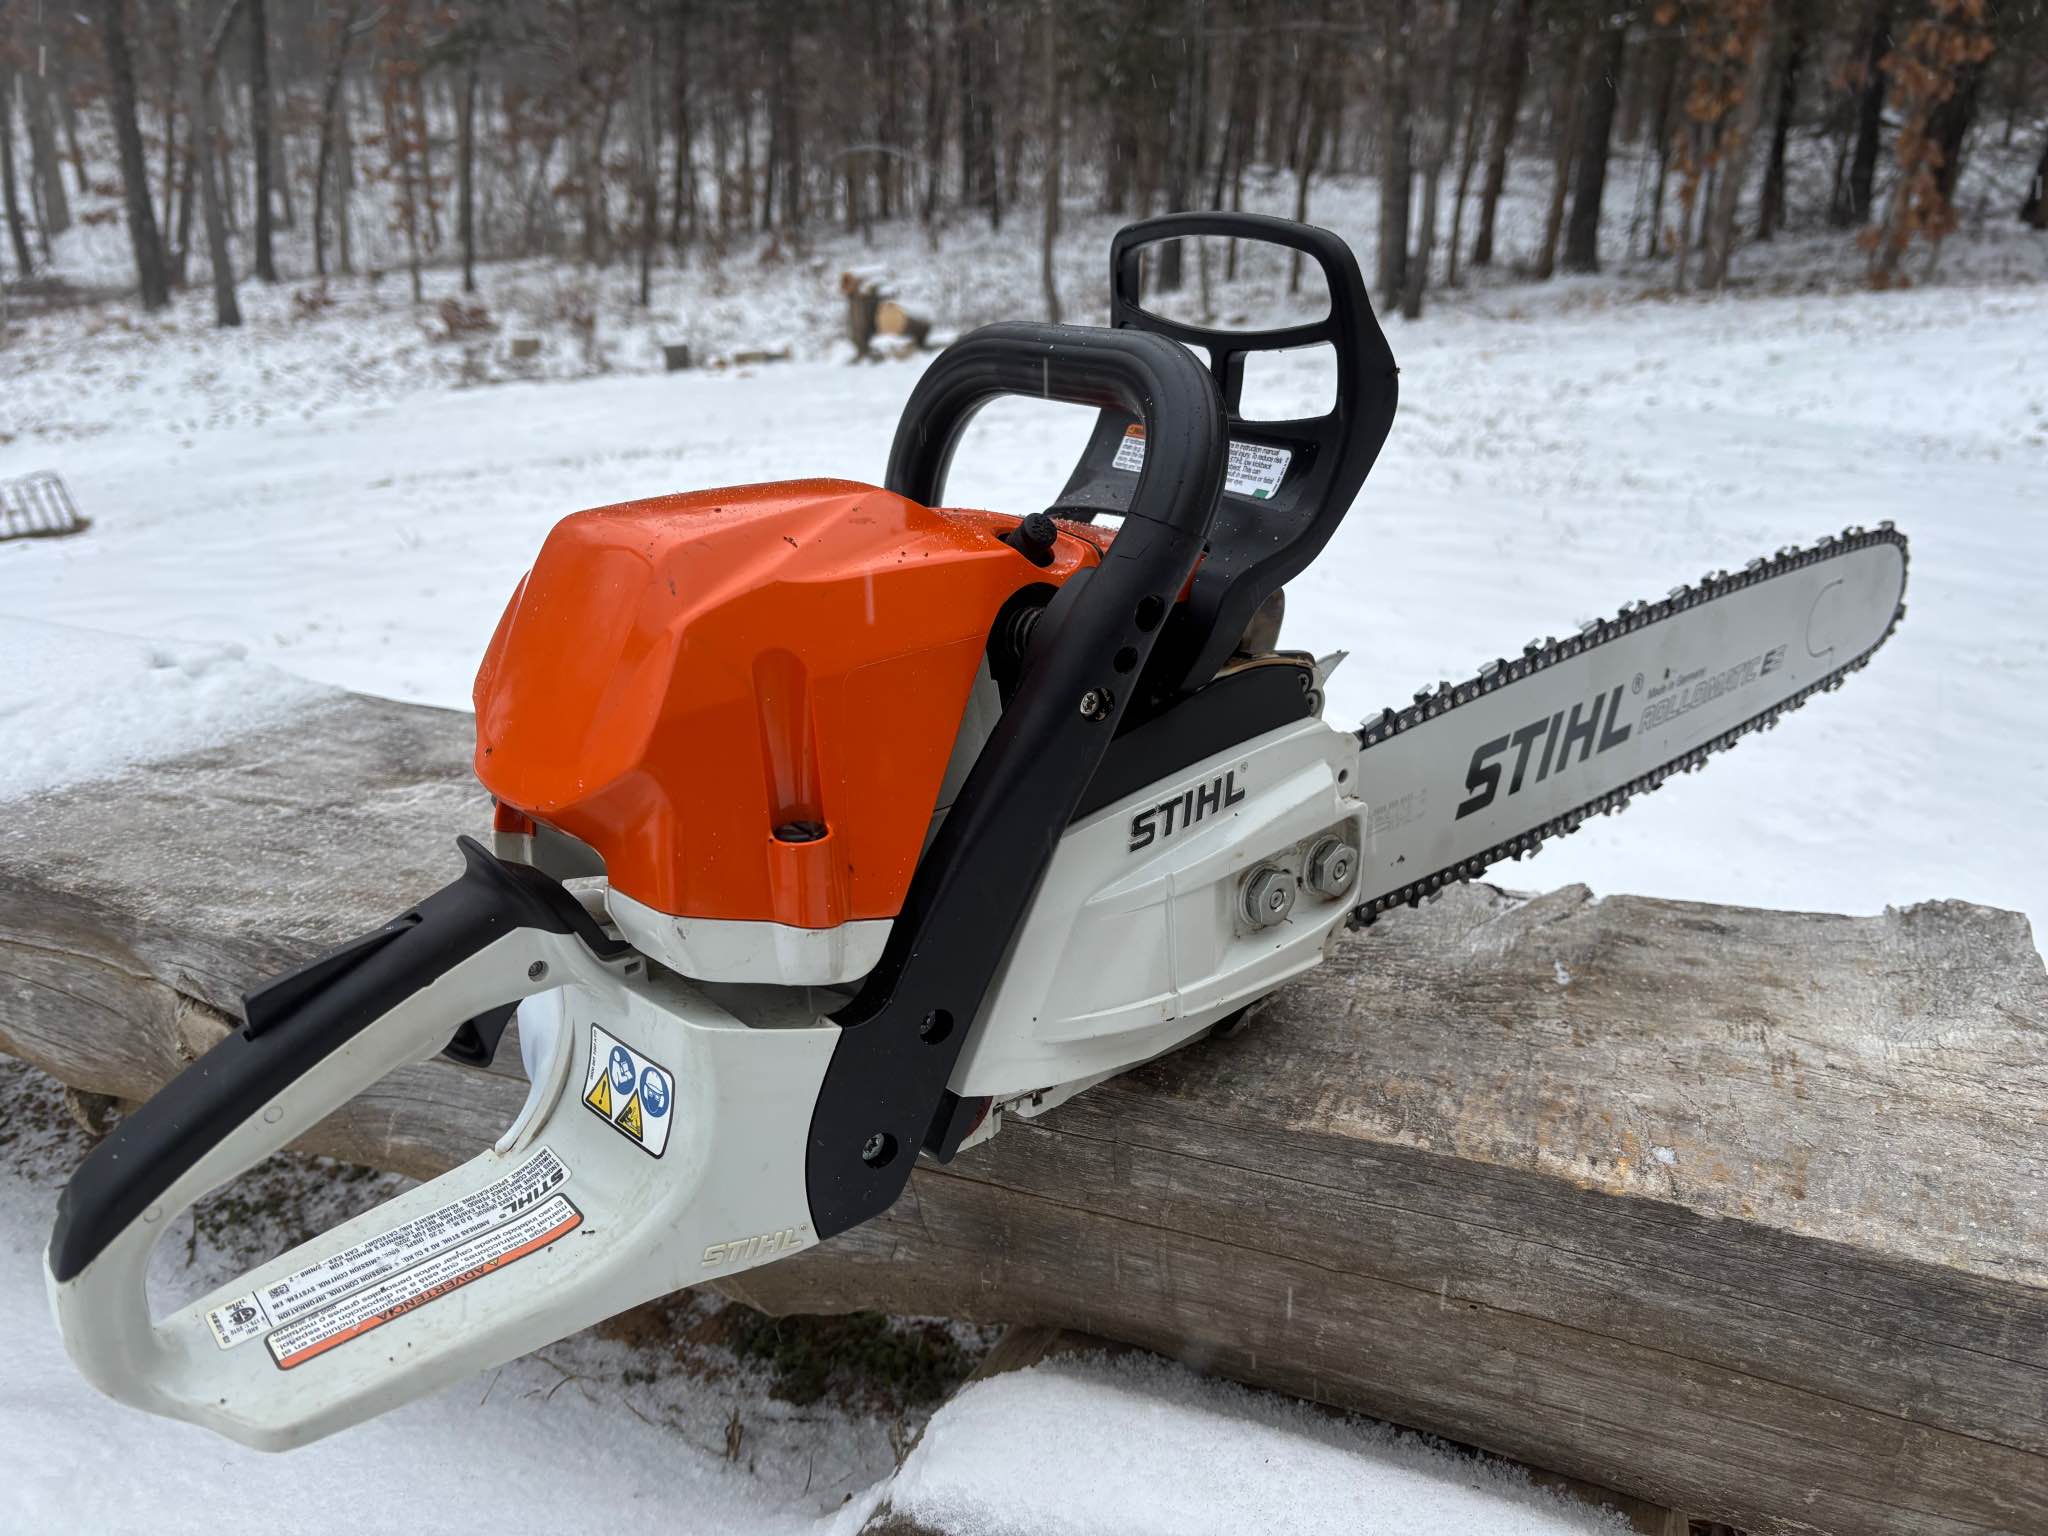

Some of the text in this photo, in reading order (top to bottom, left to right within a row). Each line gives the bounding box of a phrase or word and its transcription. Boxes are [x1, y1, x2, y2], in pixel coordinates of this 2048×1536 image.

[1455, 684, 1632, 821] STIHL
[1129, 769, 1246, 853] STIHL
[526, 1152, 551, 1176] EMISSION
[538, 1160, 559, 1179] ENGINE
[542, 1156, 556, 1169] THIS
[490, 1173, 526, 1197] COMPLIANCE
[522, 1167, 542, 1184] ENGINE
[502, 1167, 564, 1213] STIHL
[503, 1183, 521, 1197] MEETS
[413, 1202, 458, 1226] ADJUSTMENTS
[476, 1201, 488, 1210] EPA
[538, 1206, 553, 1218] uso
[414, 1218, 436, 1232] REFER
[536, 1204, 567, 1227] manual
[555, 1210, 572, 1223] Lea
[412, 1229, 426, 1239] FOR
[460, 1218, 490, 1236] ANDREAS
[501, 1216, 537, 1238] indebido
[523, 1224, 535, 1234] de
[440, 1232, 460, 1245] STIHL
[472, 1233, 501, 1251] puede
[502, 1236, 527, 1252] todas
[701, 1229, 802, 1267] STIHL
[344, 1247, 358, 1257] CAN
[344, 1246, 373, 1263] MANUAL
[442, 1246, 472, 1265] causar
[328, 1260, 343, 1270] FOR
[359, 1262, 392, 1282] EMISSION
[412, 1262, 441, 1279] daños
[422, 1256, 485, 1289] precauciones
[317, 1270, 348, 1289] CONTROL
[327, 1278, 359, 1297] CONTROL
[375, 1264, 486, 1322] ADVERTENCIA
[408, 1287, 420, 1296] de
[276, 1293, 326, 1321] INFORMATION
[326, 1299, 360, 1318] graves
[337, 1291, 393, 1322] disposición
[356, 1292, 406, 1320] seguridad
[309, 1318, 355, 1343] incluidas
